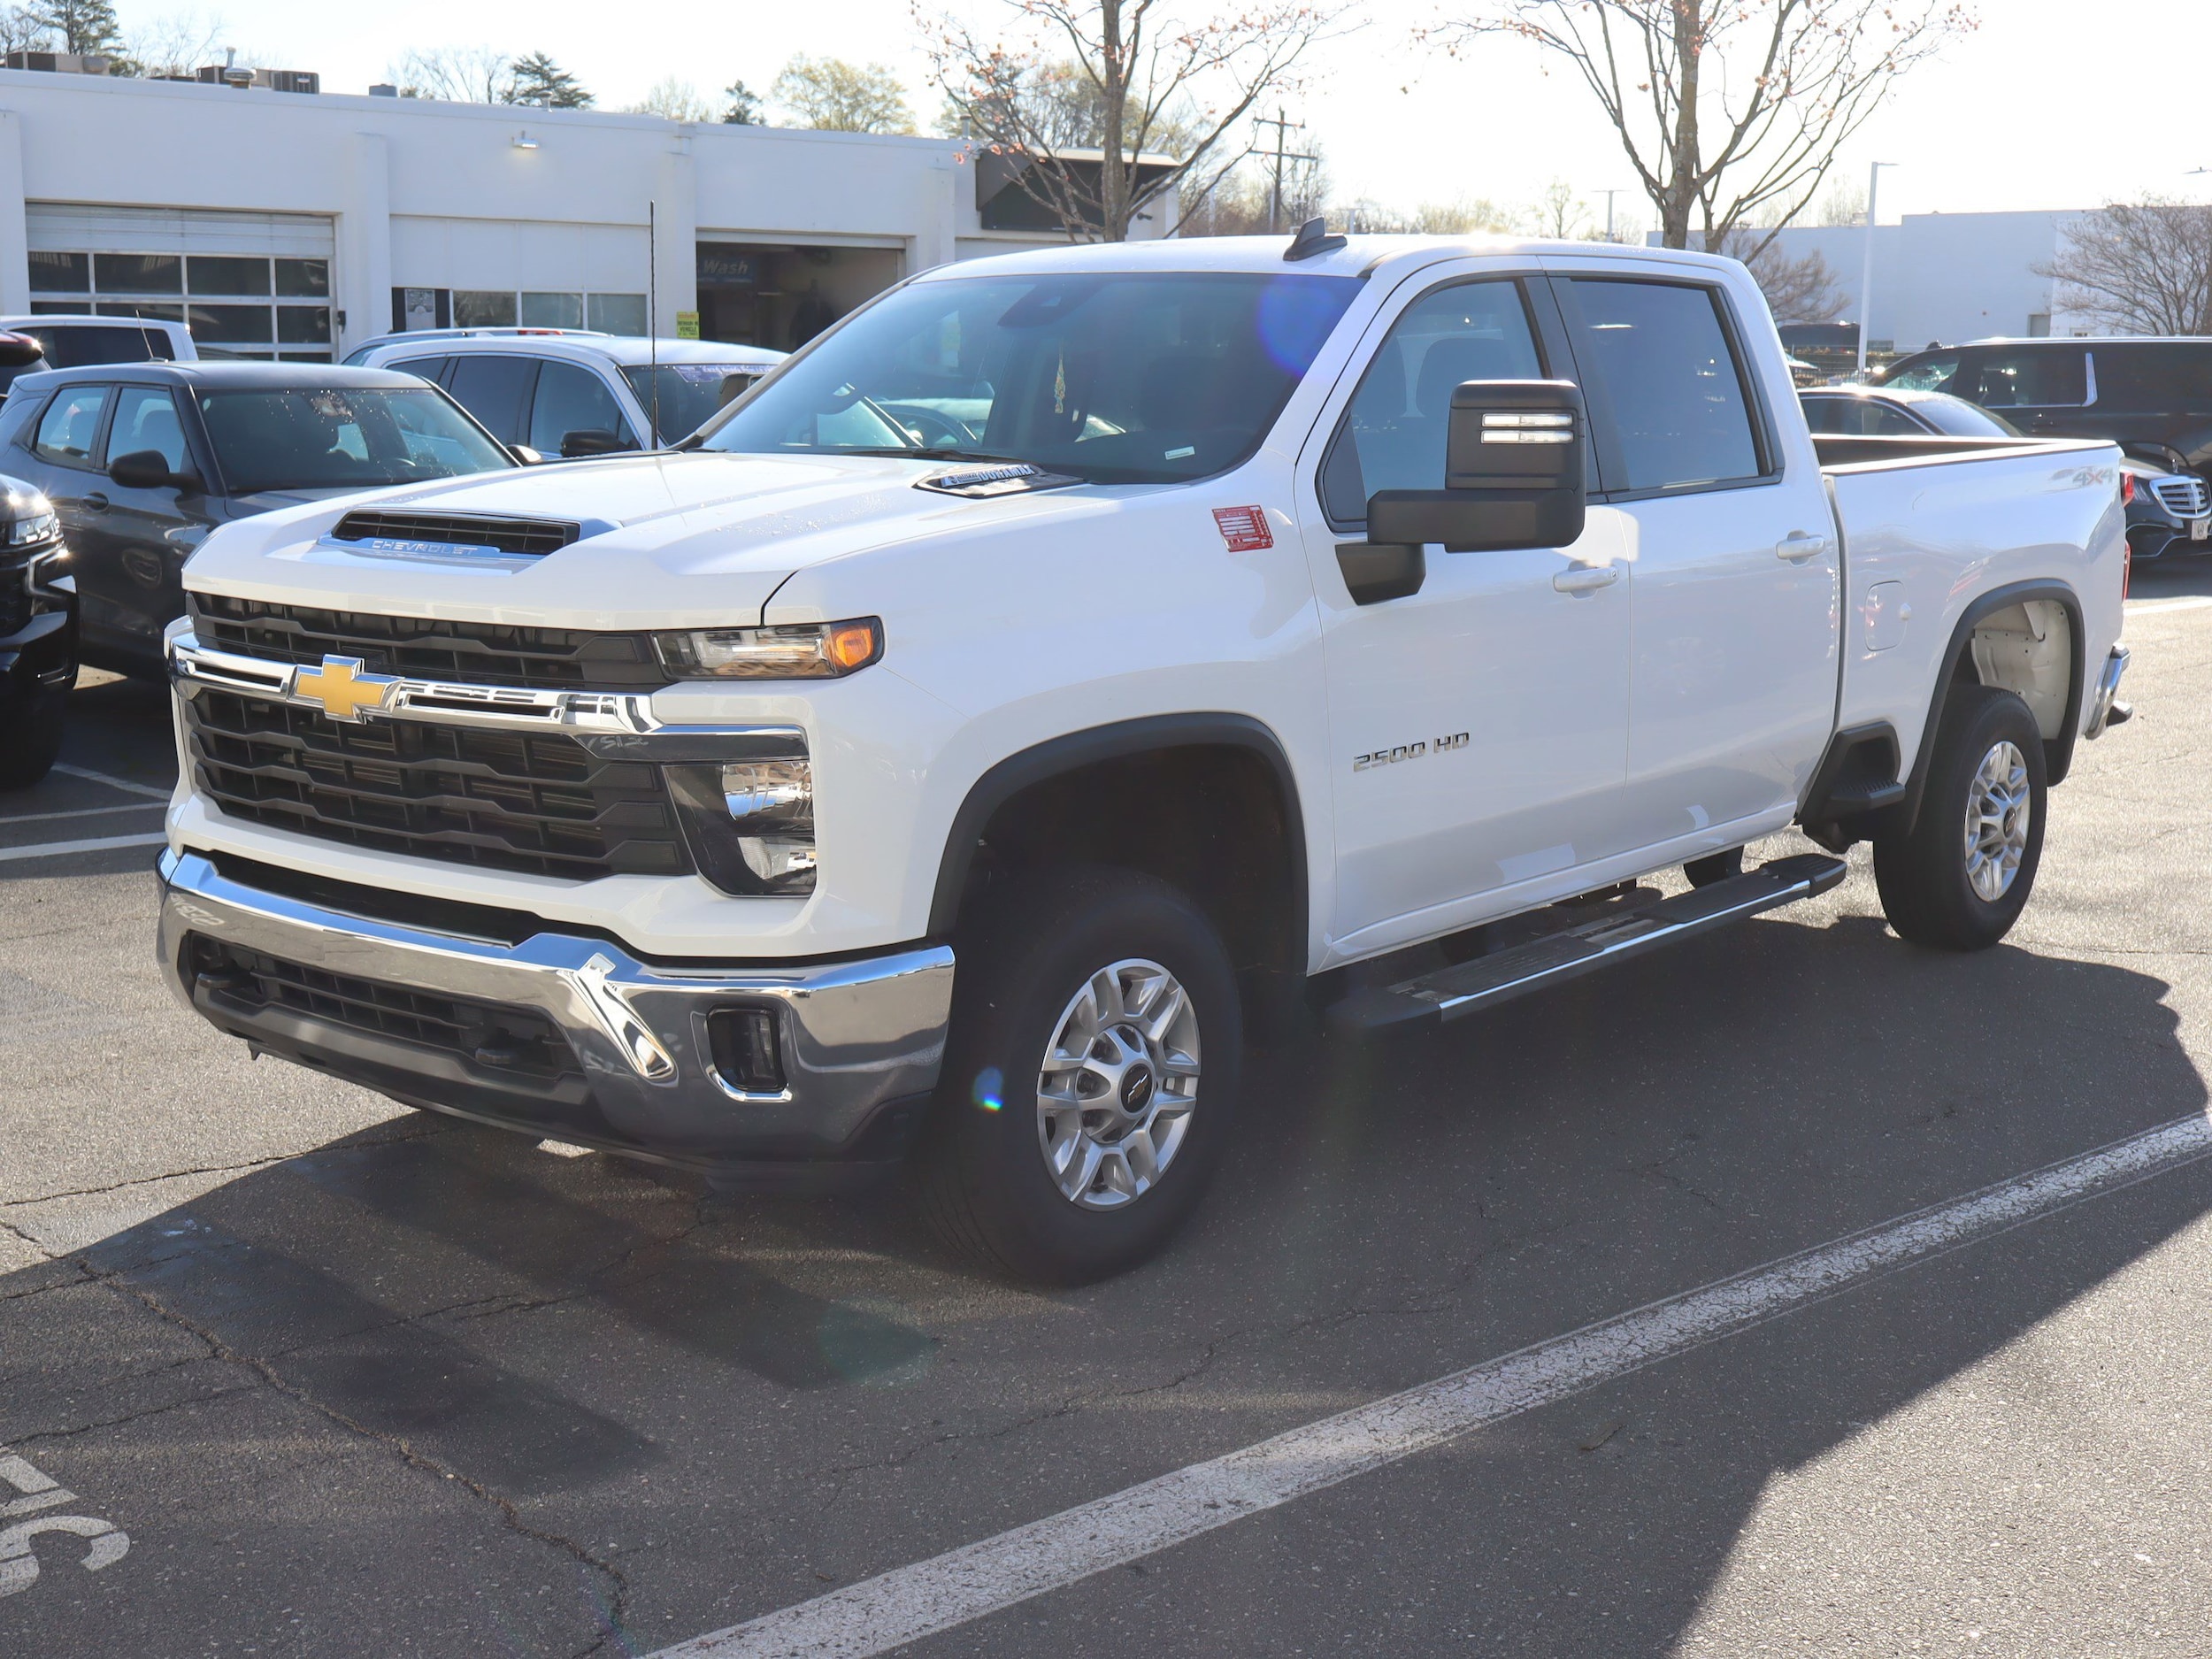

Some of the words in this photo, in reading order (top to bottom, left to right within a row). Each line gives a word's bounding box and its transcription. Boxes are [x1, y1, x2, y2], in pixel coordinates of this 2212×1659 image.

[703, 259, 749, 275] Wash
[978, 465, 1035, 481] DURAMAX
[372, 540, 478, 556] CHEVROLET
[1353, 741, 1426, 772] 2500
[1433, 732, 1470, 754] HD
